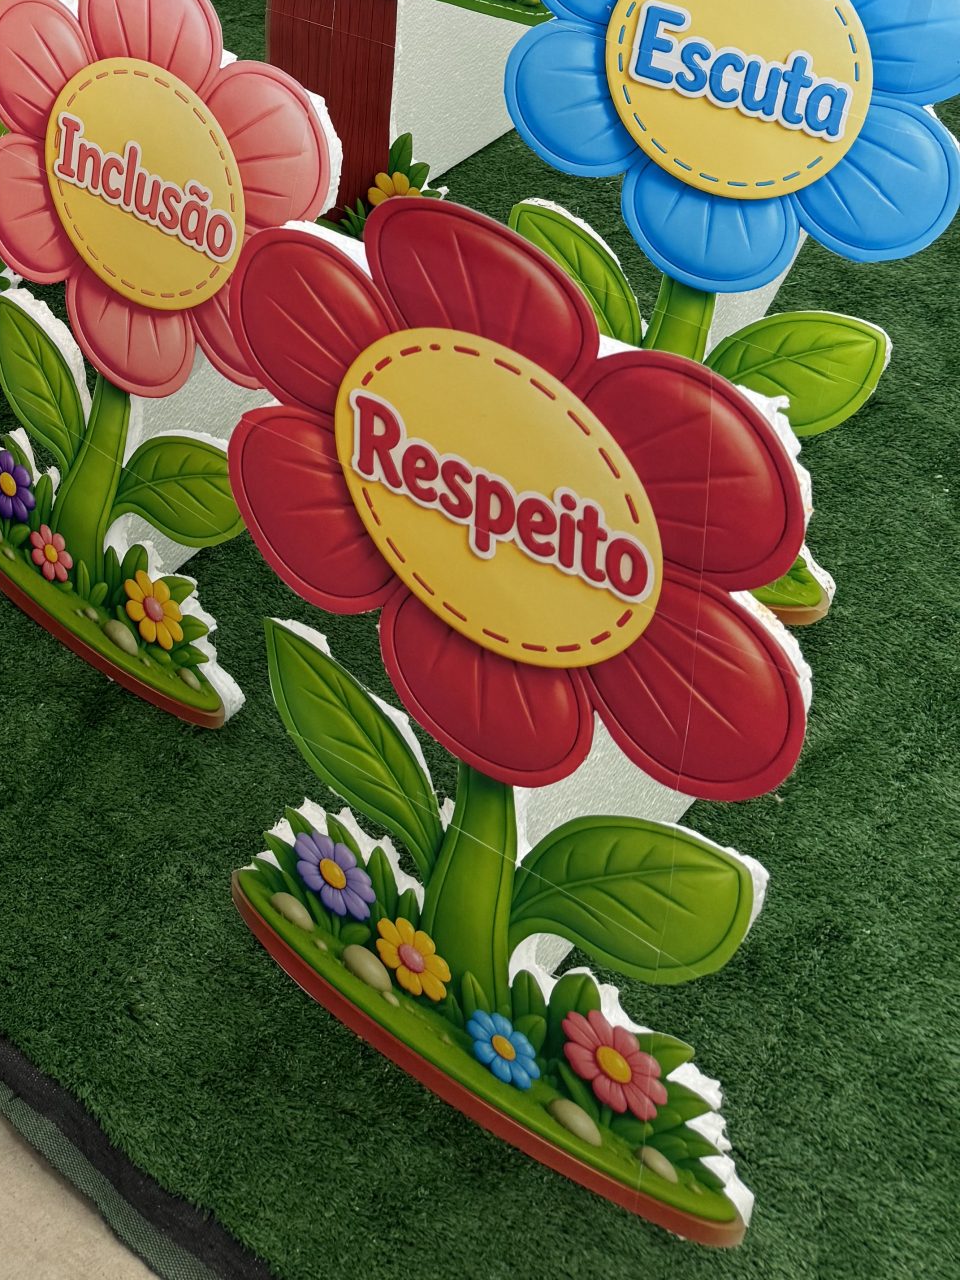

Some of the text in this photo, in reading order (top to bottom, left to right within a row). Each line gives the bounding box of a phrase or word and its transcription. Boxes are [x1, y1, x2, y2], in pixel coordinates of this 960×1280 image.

[633, 4, 849, 138] Escuta
[55, 115, 235, 259] Inclusão
[353, 392, 651, 599] Respeito
